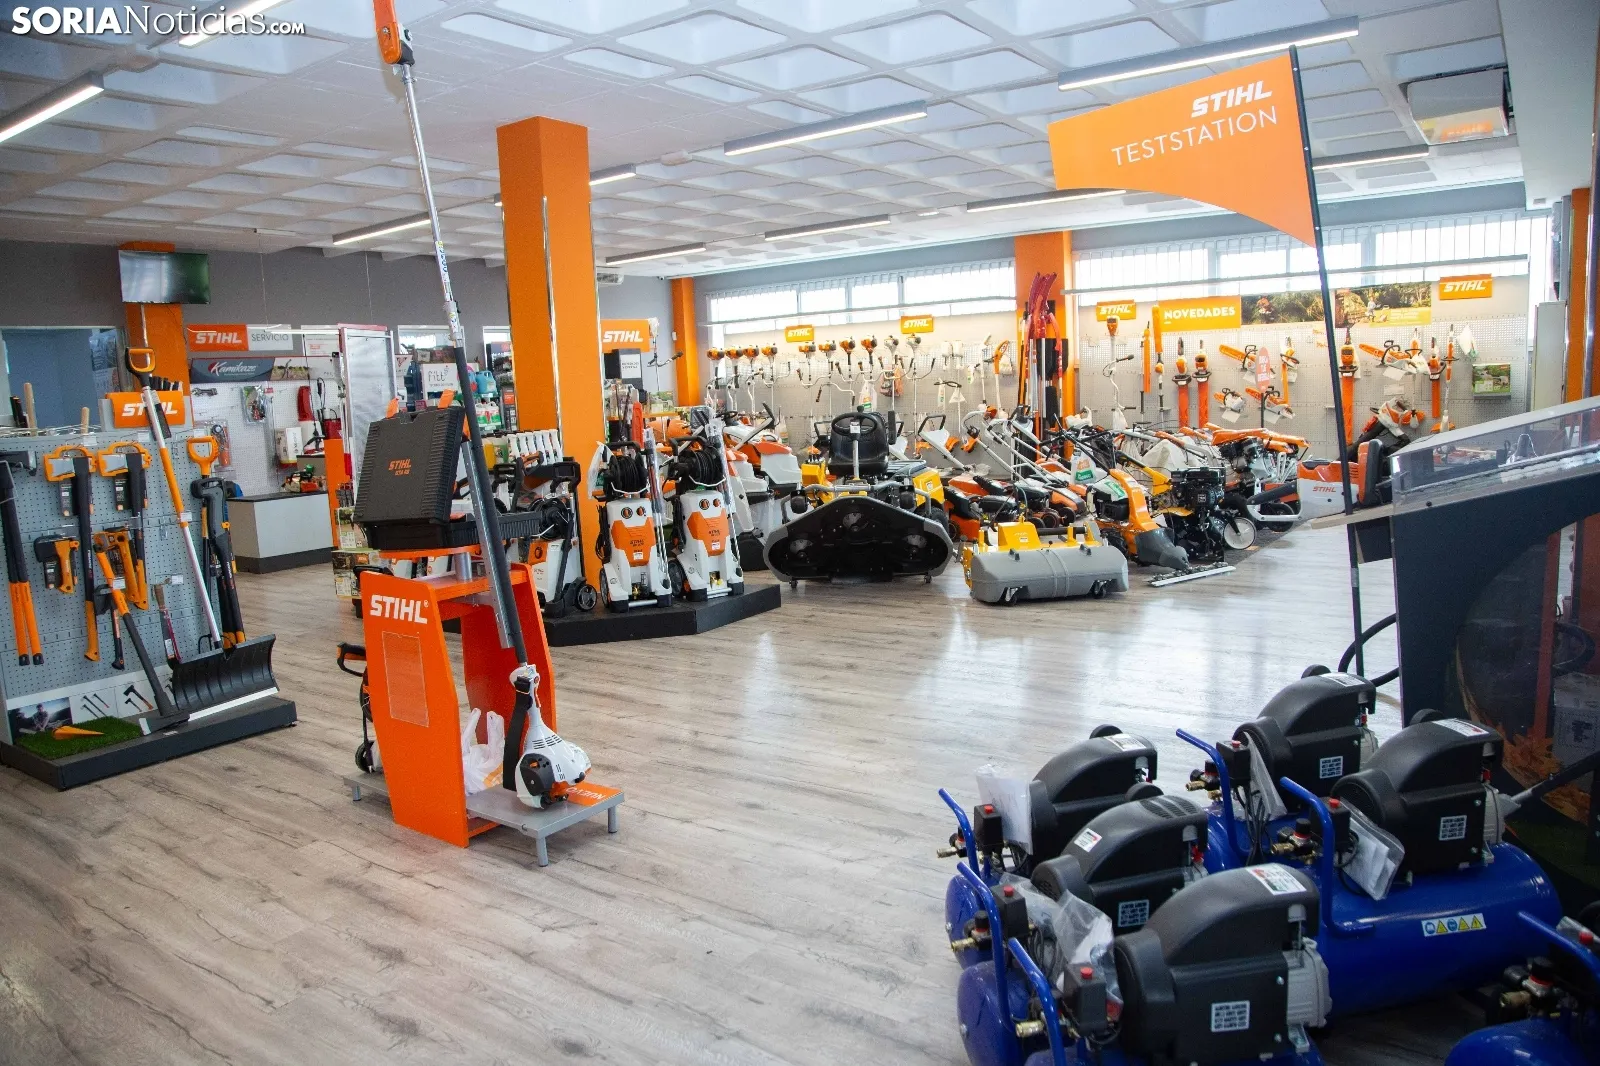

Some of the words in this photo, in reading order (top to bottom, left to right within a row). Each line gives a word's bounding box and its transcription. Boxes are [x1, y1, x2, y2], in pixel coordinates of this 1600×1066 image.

[1191, 80, 1273, 118] STIHL
[1111, 105, 1278, 166] TESTSTATION
[1443, 280, 1486, 293] STIHL
[1099, 304, 1131, 315] STIHL
[1163, 306, 1236, 320] NOVEDADES
[195, 332, 242, 344] STIHL
[251, 333, 289, 342] SERVICIO
[602, 330, 643, 343] STIHL
[210, 361, 257, 376] Kamikaze
[389, 458, 412, 470] STIHL
